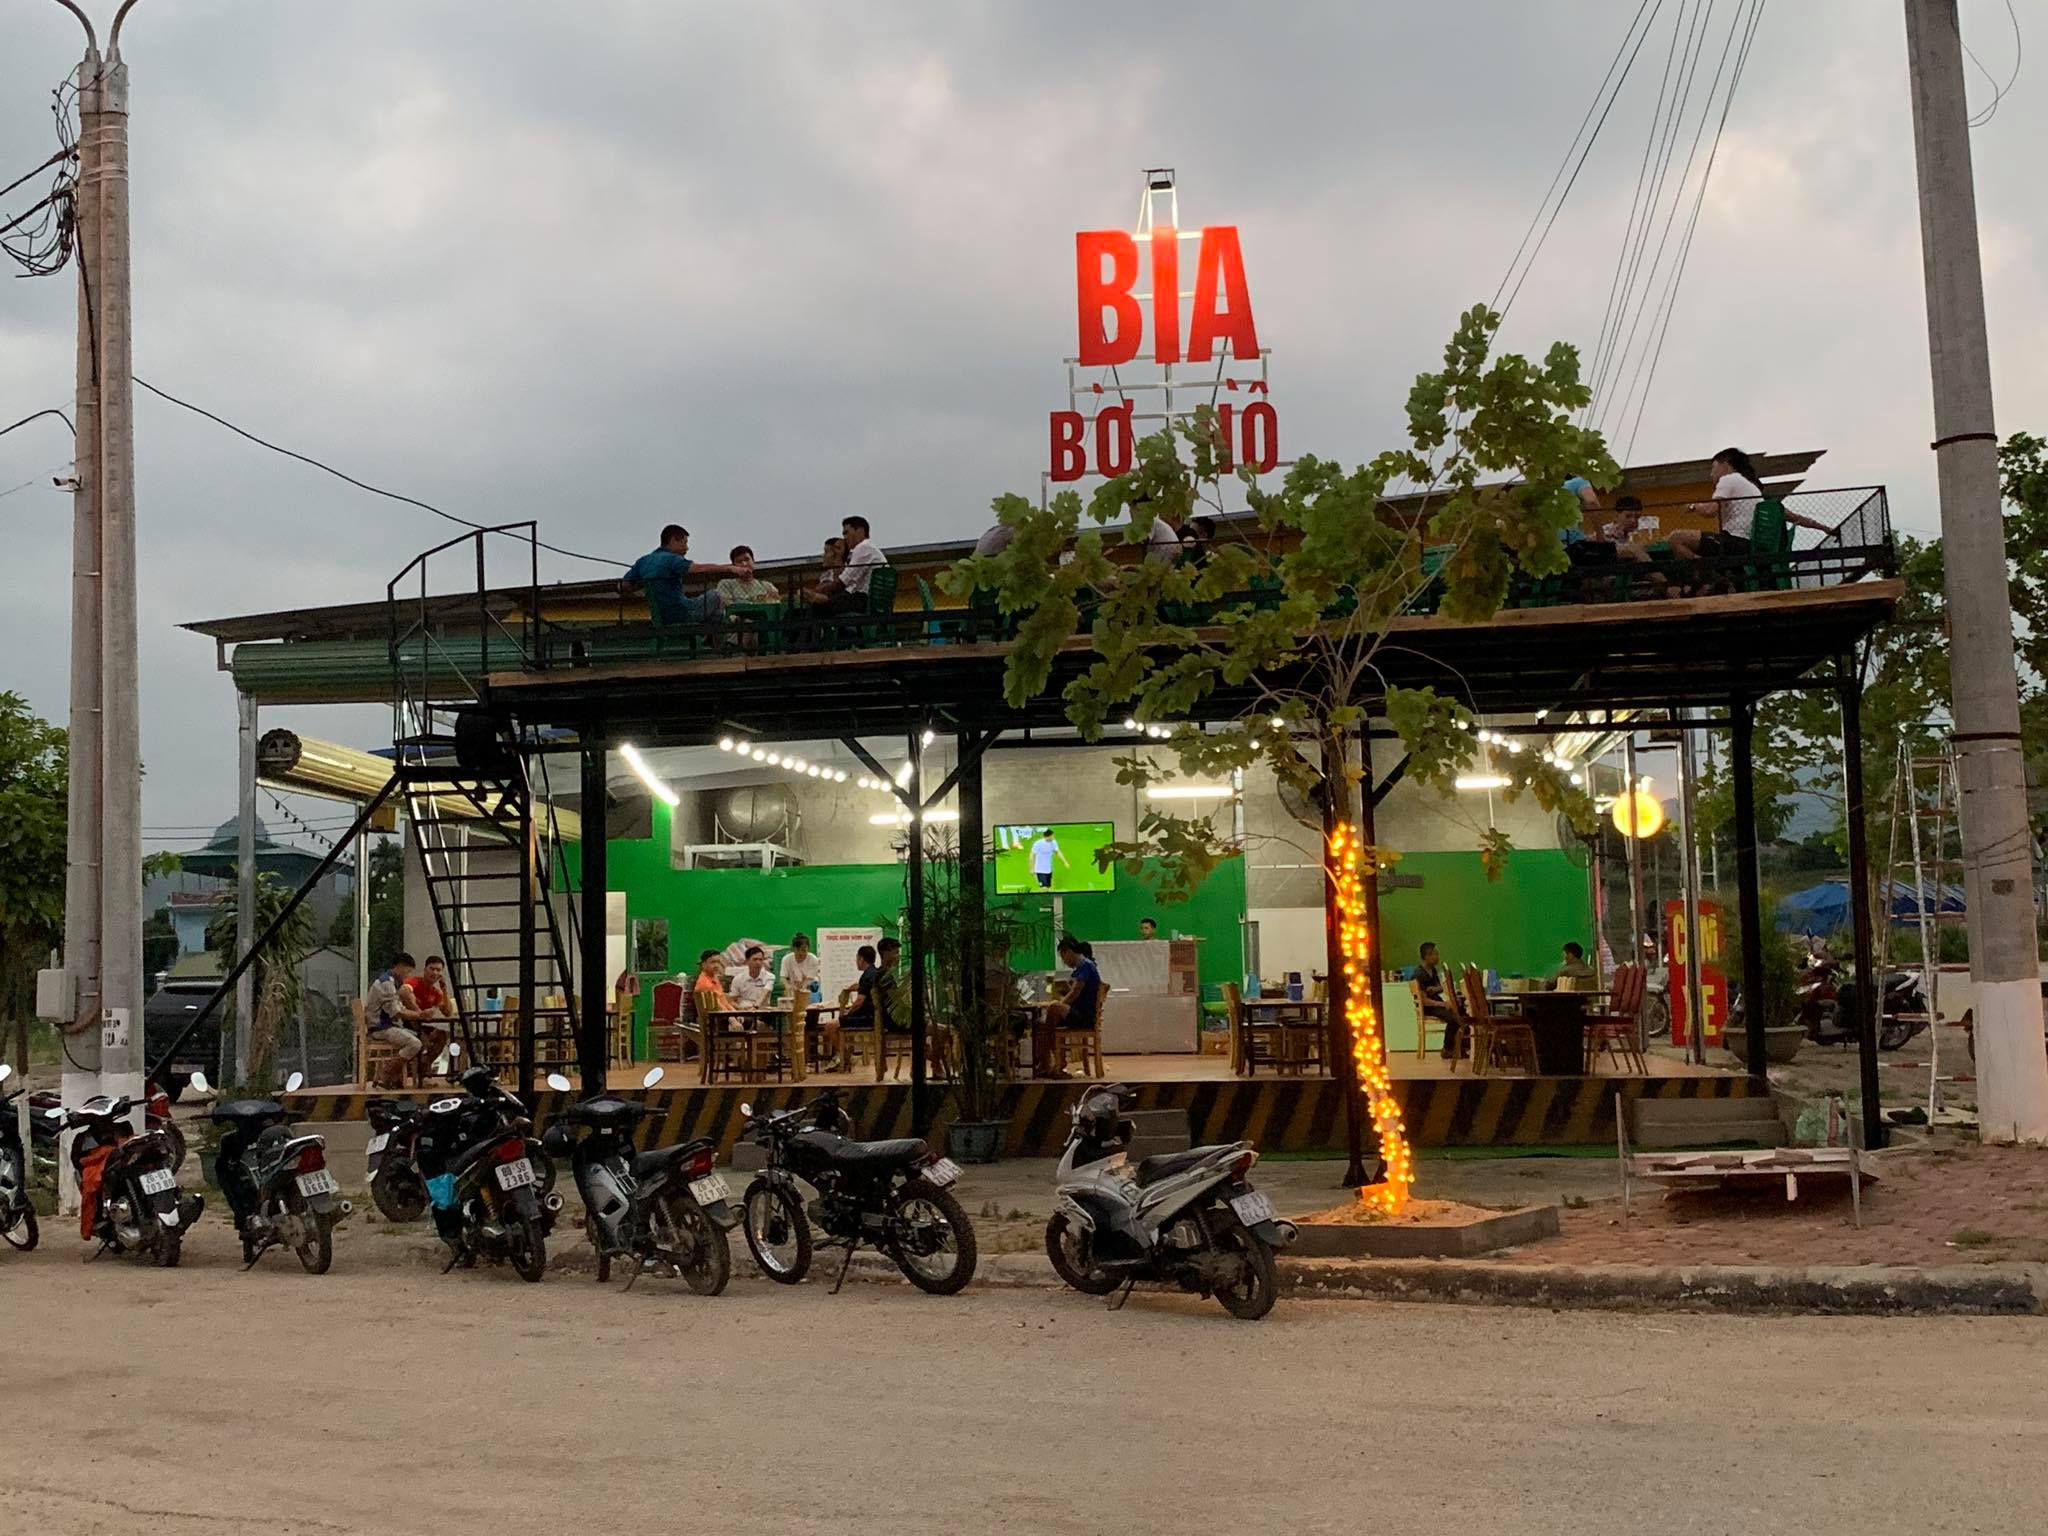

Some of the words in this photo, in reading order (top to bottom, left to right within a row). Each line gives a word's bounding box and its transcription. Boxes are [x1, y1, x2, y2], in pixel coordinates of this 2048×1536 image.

[1075, 225, 1260, 367] BIA
[1050, 383, 1134, 482] BỜ
[1672, 913, 1719, 965] CM
